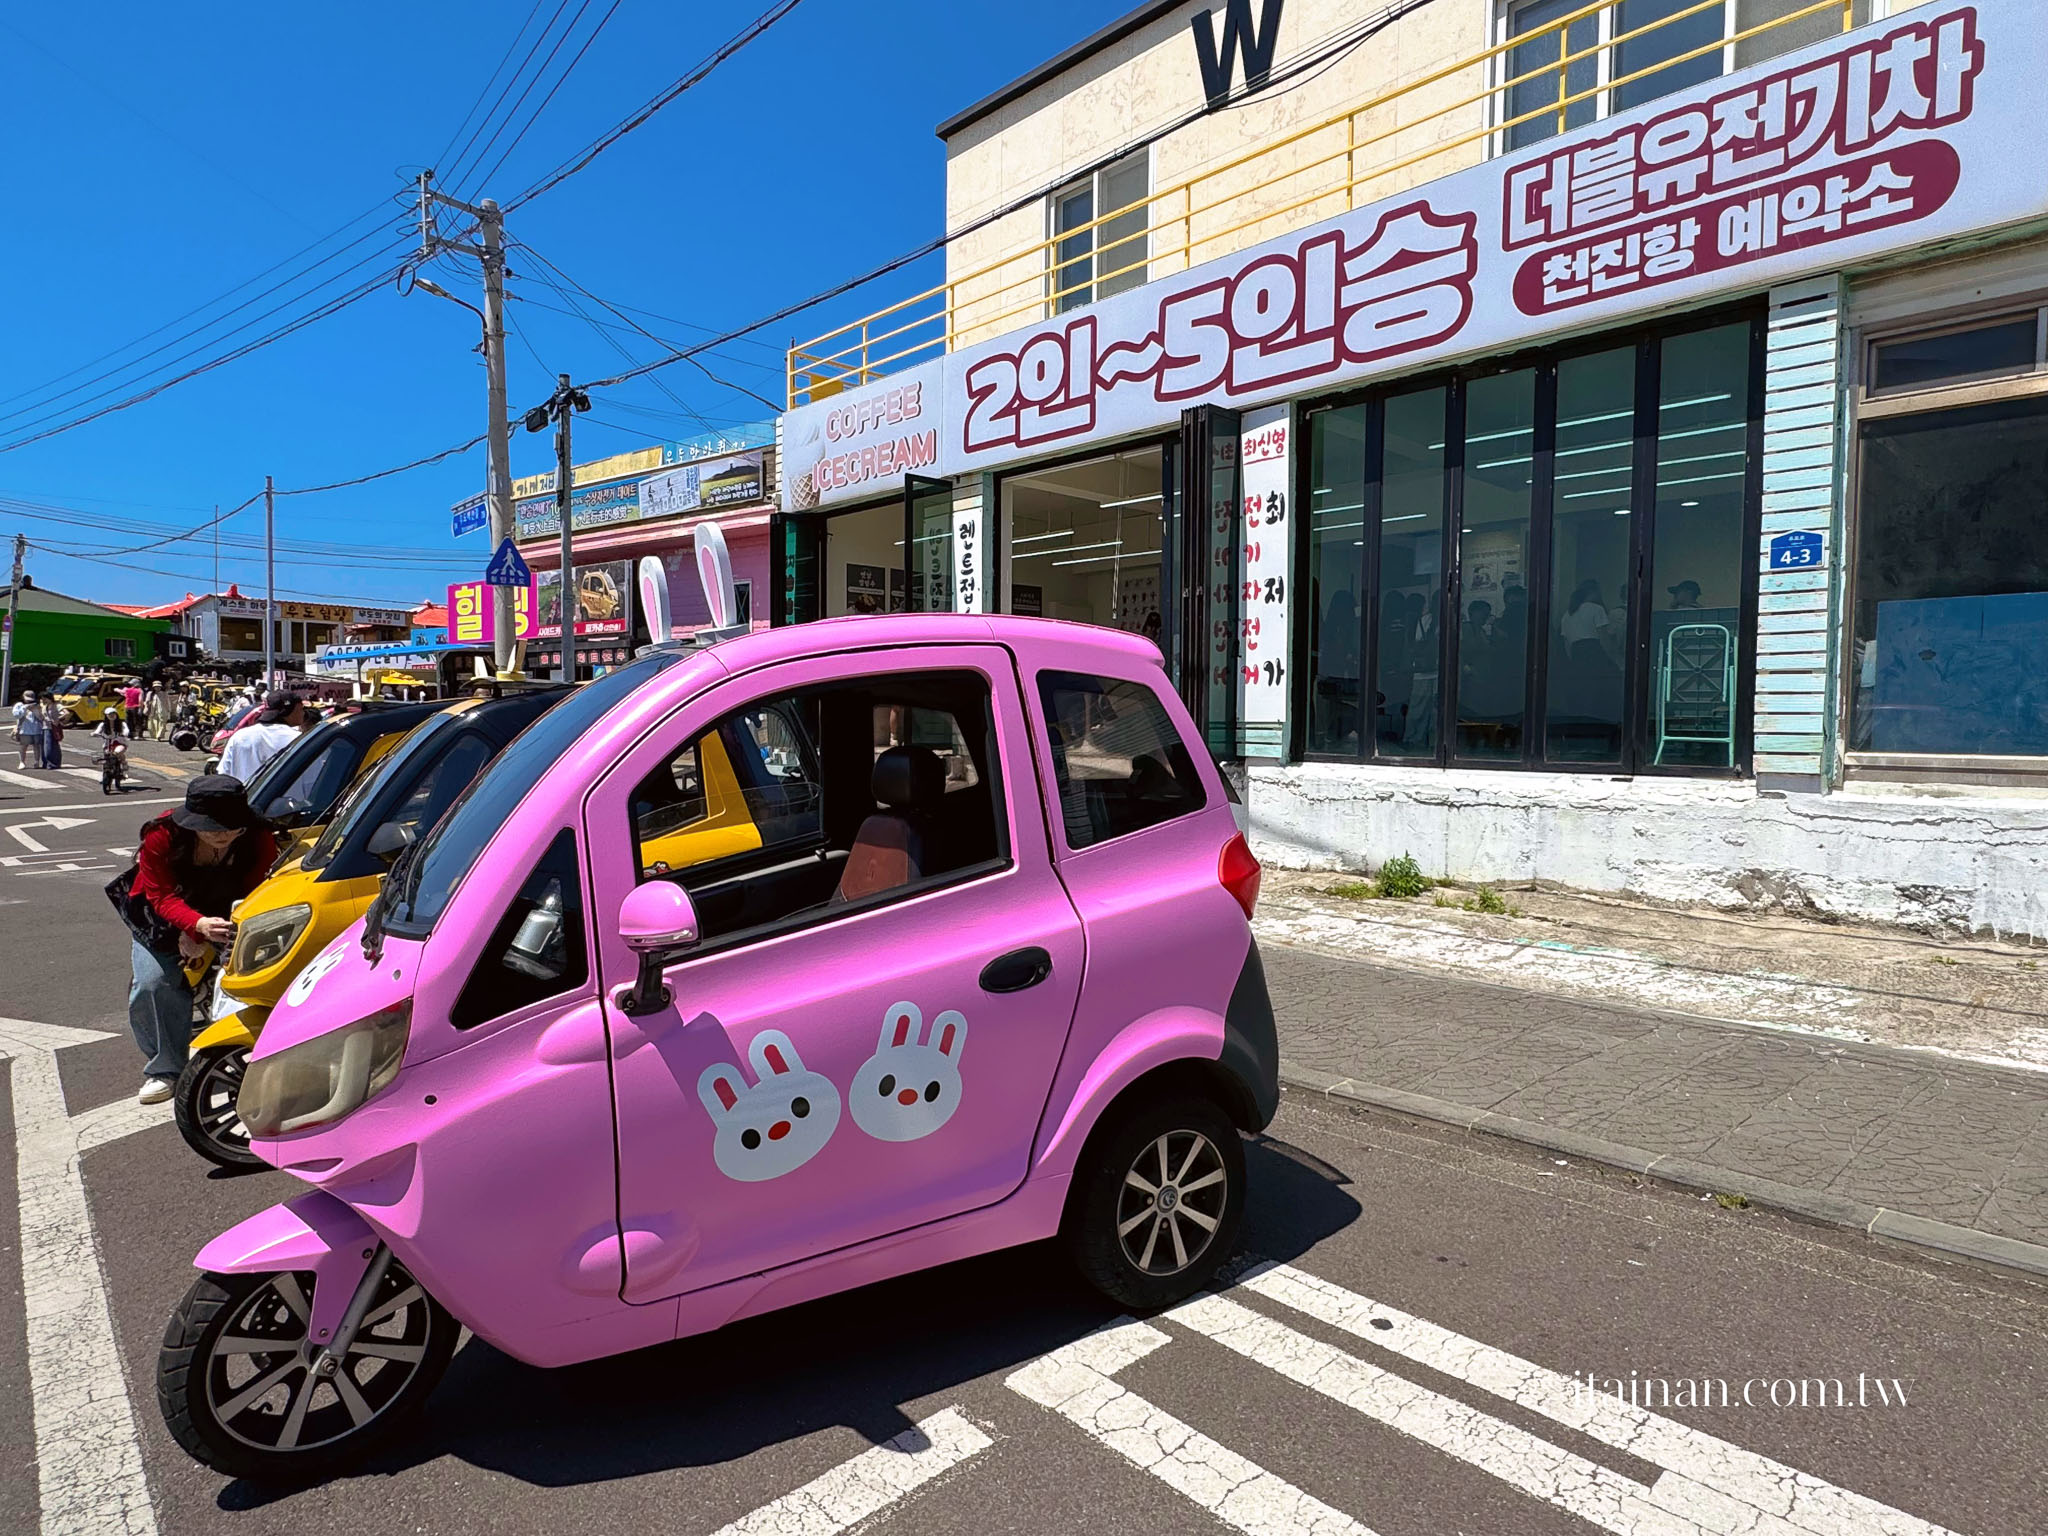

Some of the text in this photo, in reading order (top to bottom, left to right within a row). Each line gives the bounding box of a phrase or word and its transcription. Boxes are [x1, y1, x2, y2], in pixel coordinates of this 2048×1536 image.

[1190, 0, 1284, 110] W
[1503, 8, 1984, 251] 더블유전기차
[1542, 161, 1913, 306] 천진항 예약소
[964, 200, 1478, 454] 2인~5인승
[825, 381, 922, 443] COFFEE
[811, 428, 937, 493] ICECREAM
[959, 520, 976, 613] 렌트접
[1780, 548, 1811, 564] 4-3
[219, 599, 247, 609] 게스트
